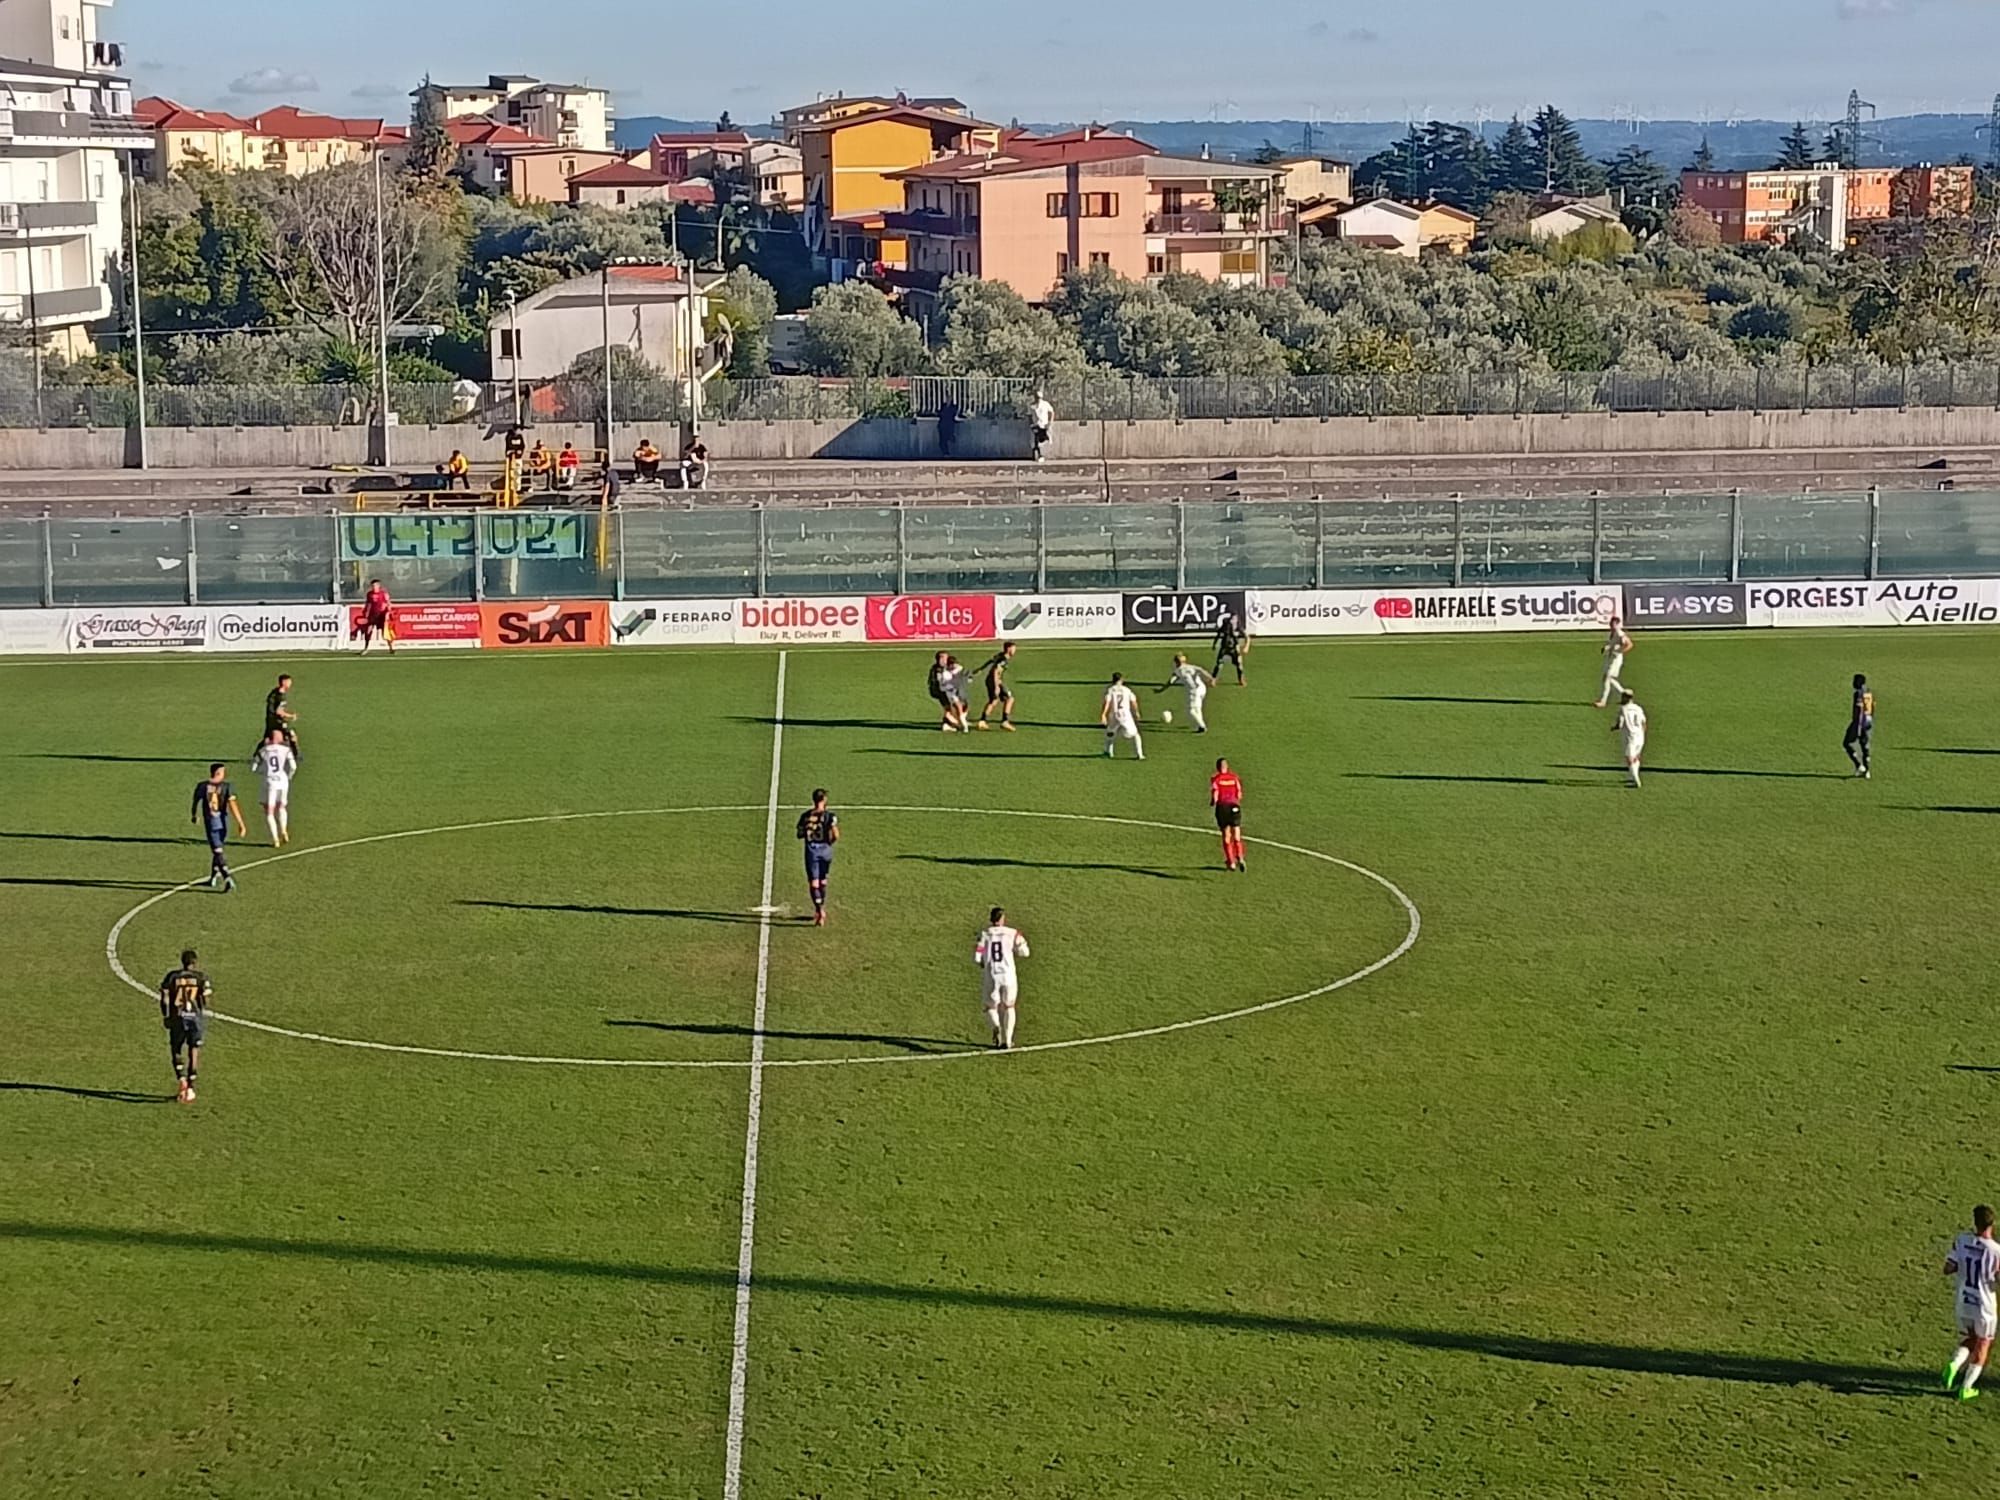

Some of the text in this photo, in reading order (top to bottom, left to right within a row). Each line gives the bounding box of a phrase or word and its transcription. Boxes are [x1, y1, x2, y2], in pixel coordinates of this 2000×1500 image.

[1750, 587, 1868, 609] FORGEST
[1876, 582, 1958, 601] Auto
[742, 600, 859, 628] bidibee
[906, 599, 973, 626] Fides
[1048, 606, 1116, 617] FERRARO
[1270, 604, 1340, 618] Paradiso
[1415, 596, 1496, 618] RAFFAELE
[1635, 596, 1734, 615] LEASYS
[1905, 602, 1998, 622] Aiello
[223, 616, 339, 633] mediolanum
[662, 611, 732, 623] FERRARO
[1048, 618, 1093, 629] GROUP
[662, 624, 709, 634] GROUP
[795, 630, 828, 639] Deliver
[270, 755, 279, 773] 9
[991, 941, 1003, 962] 8
